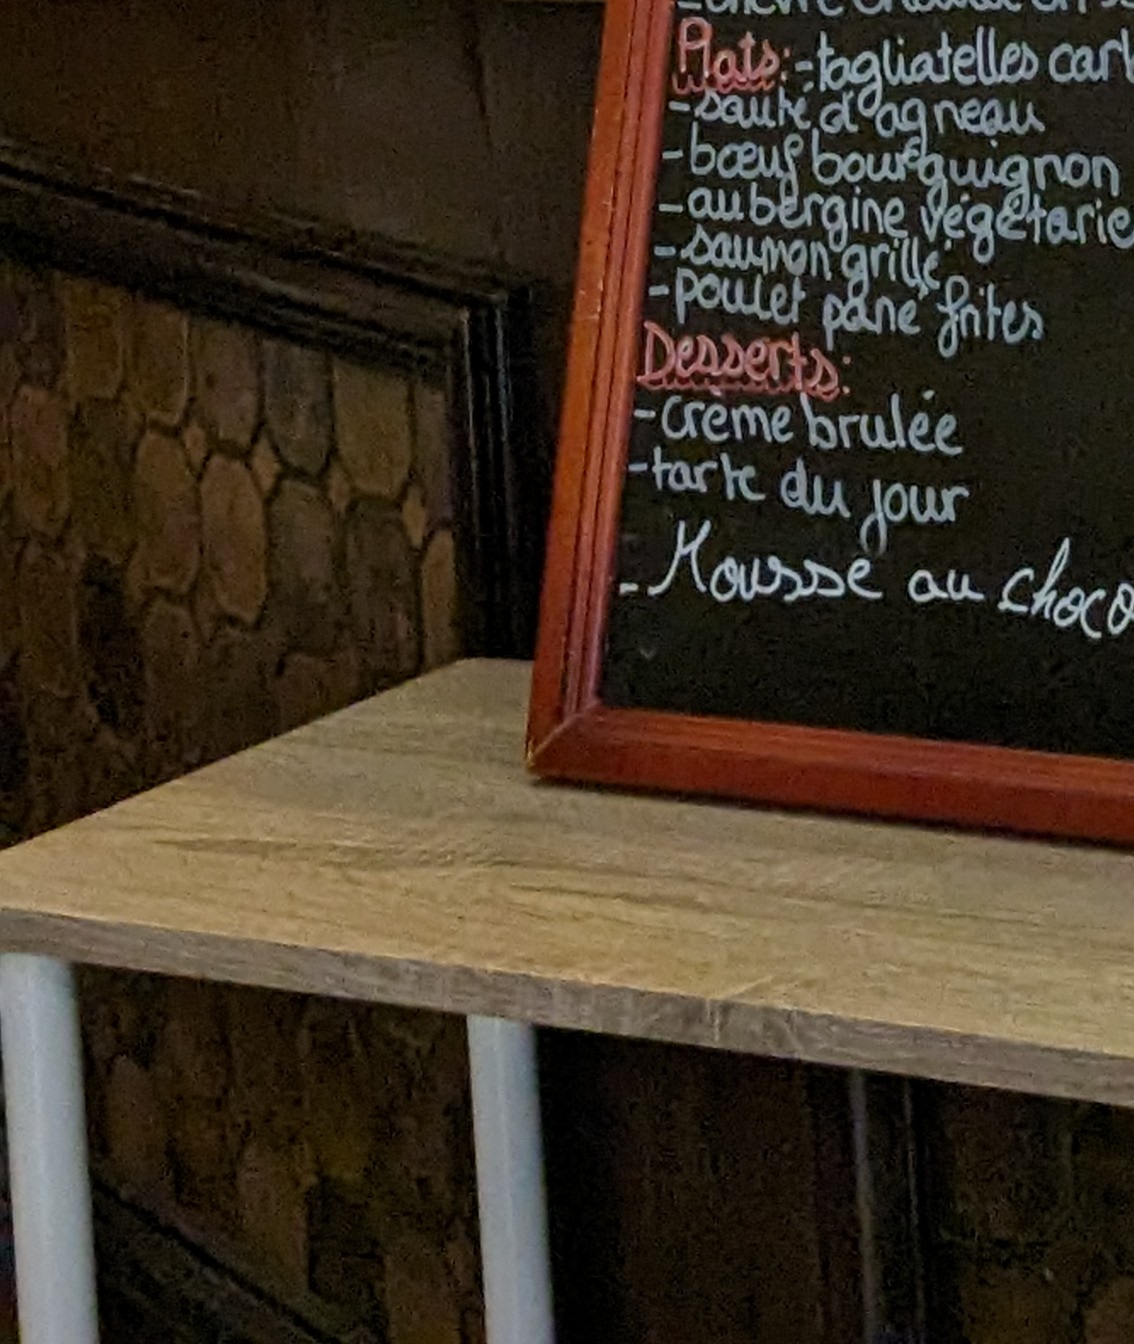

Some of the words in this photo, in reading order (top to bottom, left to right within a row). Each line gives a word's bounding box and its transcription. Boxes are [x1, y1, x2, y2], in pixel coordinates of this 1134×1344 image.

[811, 127, 1121, 219] bourguignon
[841, 235, 953, 302] grillé
[937, 274, 1043, 358] frites
[638, 320, 852, 395] Desserts:
[799, 389, 964, 456] brulée
[780, 458, 852, 519] du
[859, 478, 971, 556] jour
[908, 568, 985, 603] au
